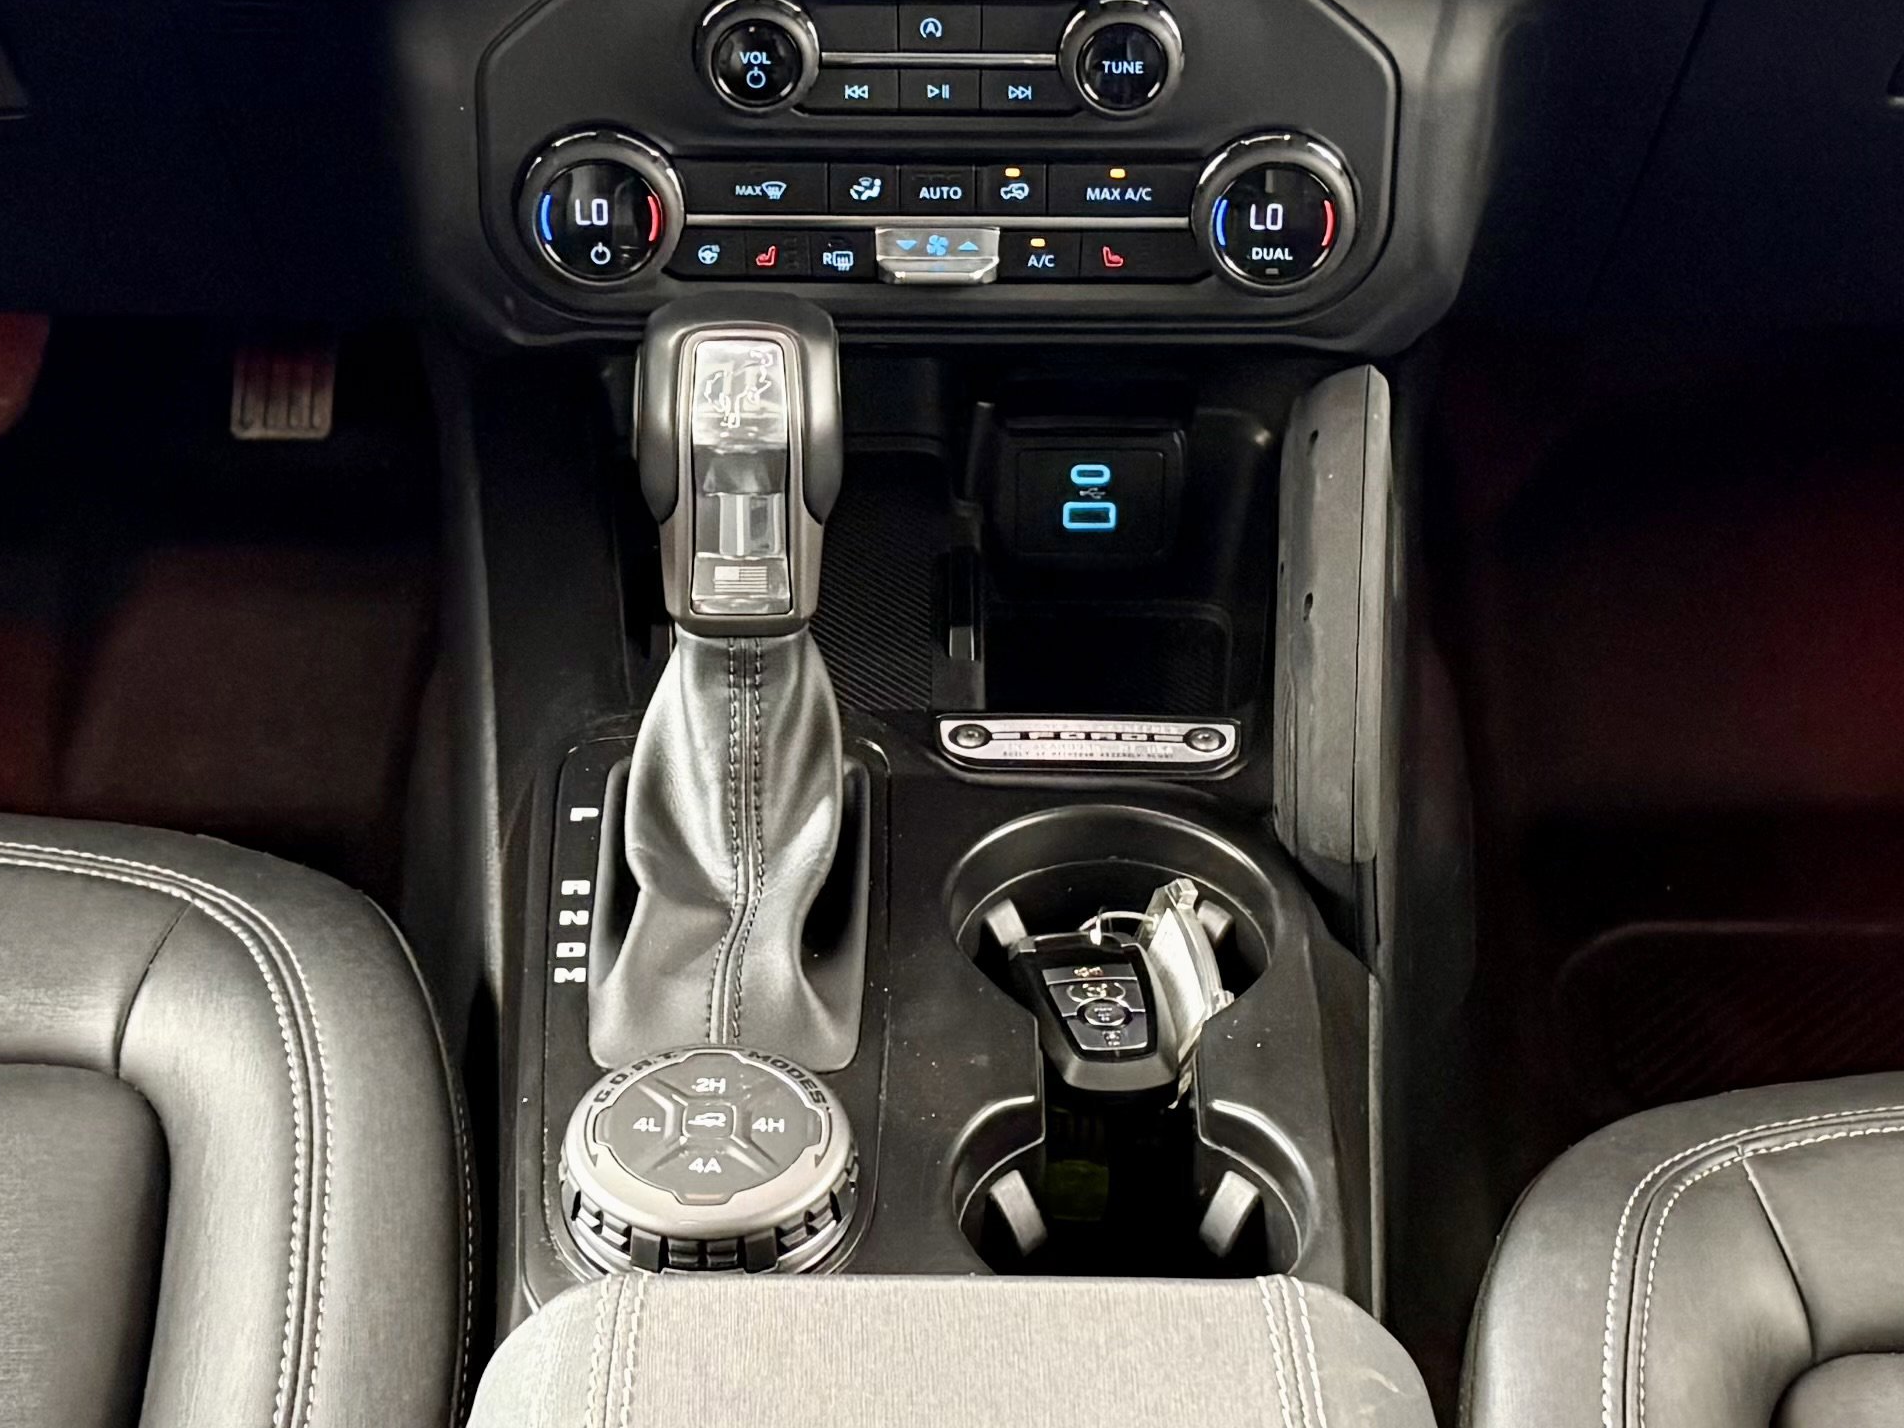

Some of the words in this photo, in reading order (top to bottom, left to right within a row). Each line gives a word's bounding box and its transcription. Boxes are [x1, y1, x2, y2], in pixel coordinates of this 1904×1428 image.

[738, 50, 772, 65] VOL
[1101, 59, 1144, 75] TUNE
[734, 183, 763, 197] MAX
[918, 186, 963, 201] AUTO
[1086, 187, 1122, 201] MAX
[1124, 186, 1153, 202] A/C
[574, 198, 610, 227] LO
[1249, 203, 1285, 232] LO
[1027, 254, 1056, 269] A/C
[1251, 247, 1294, 261] DUAL
[558, 910, 590, 926] N
[555, 942, 587, 958] D
[553, 967, 587, 984] M
[747, 1050, 829, 1105] MODES
[693, 1077, 727, 1095] 2H
[632, 1117, 662, 1133] 4L
[751, 1117, 786, 1134] 4H
[688, 1157, 723, 1174] 4A
